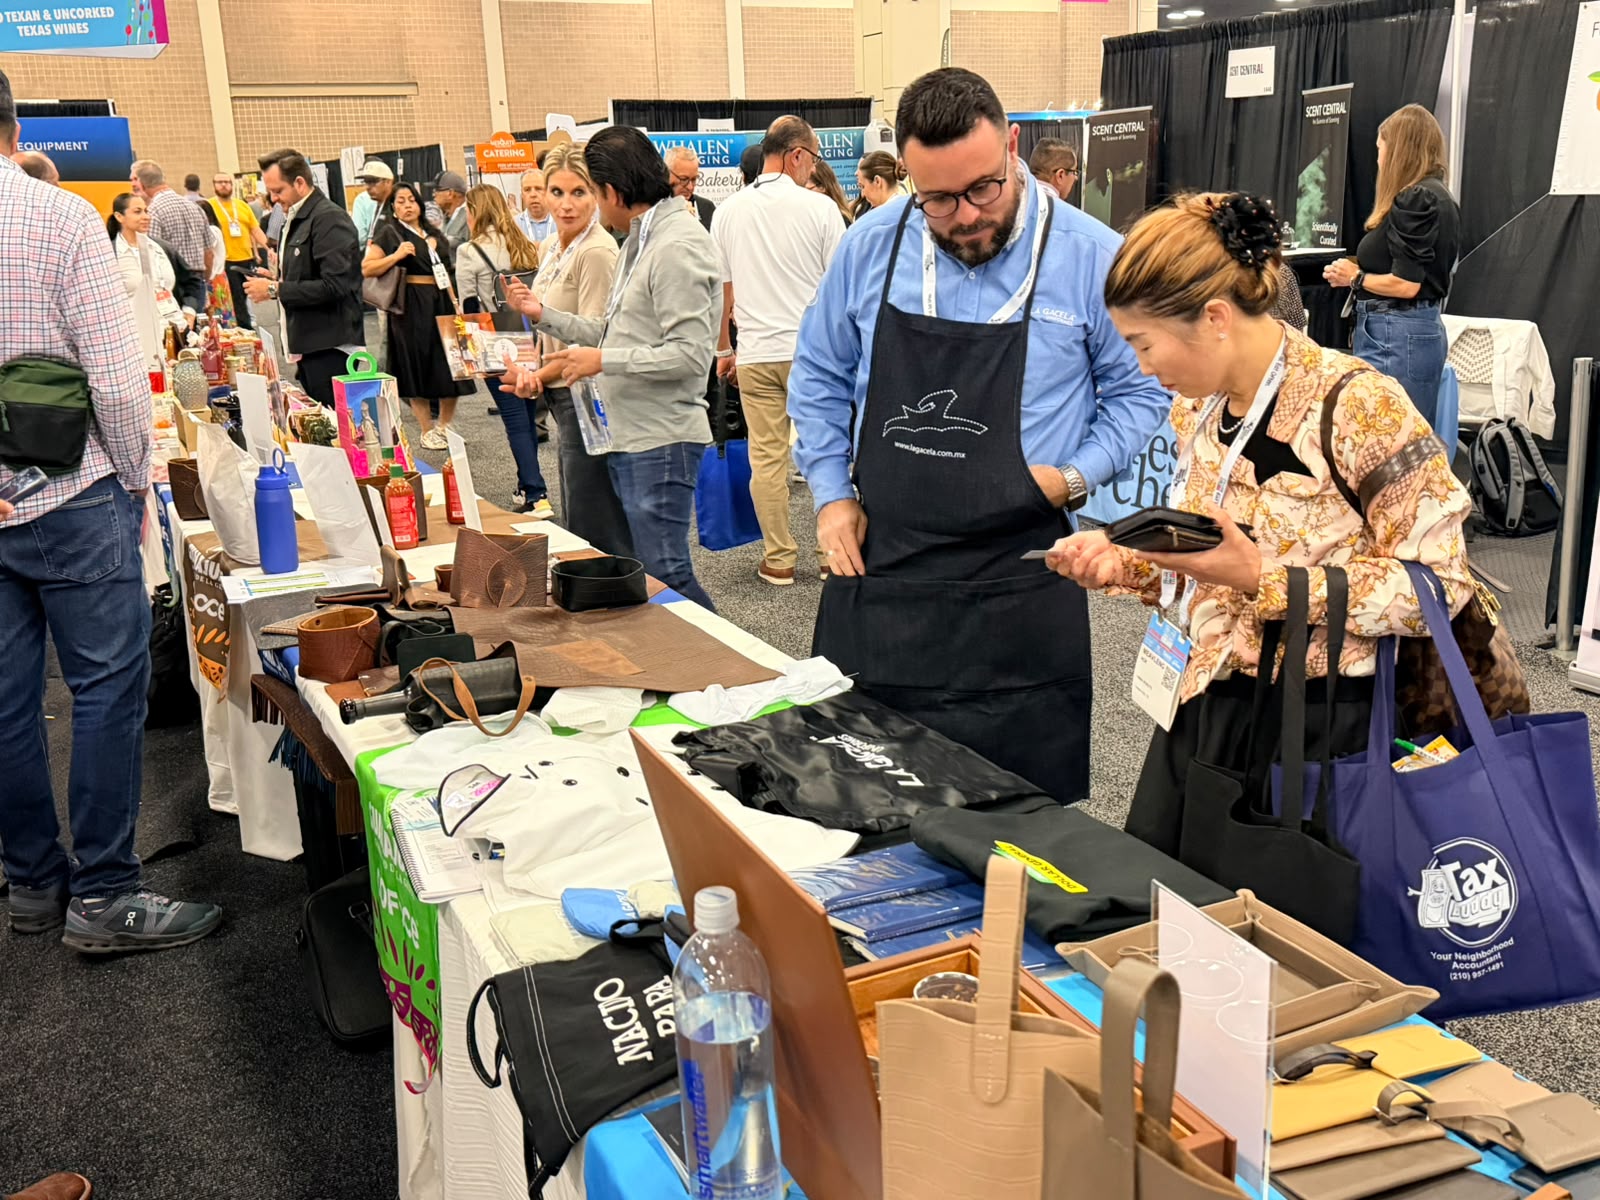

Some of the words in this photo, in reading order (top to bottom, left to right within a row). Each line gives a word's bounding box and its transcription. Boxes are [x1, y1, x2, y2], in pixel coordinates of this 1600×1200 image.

[5, 11, 40, 23] TEXAN
[43, 9, 51, 21] &
[53, 7, 114, 20] UNCORKED
[17, 25, 51, 37] TEXAS
[53, 22, 89, 35] WINES
[1240, 63, 1264, 75] CENTRAL
[1305, 105, 1323, 118] SCENT
[1322, 101, 1347, 116] CENTRAL
[1092, 124, 1113, 136] SCENT
[1114, 121, 1146, 134] CENTRAL
[17, 141, 88, 151] EQUIPMENT
[483, 149, 525, 158] CATERING
[1320, 235, 1337, 246] Curated
[894, 441, 966, 458] www.lagacela.com.mx
[1041, 865, 1079, 889] DOLLAR
[1440, 857, 1507, 902] Tax
[1430, 951, 1452, 961] Your
[1454, 937, 1514, 962] Neighborhood
[1451, 952, 1502, 970] Accountant
[1449, 971, 1471, 981] (210)
[689, 1070, 714, 1200] smartwater
